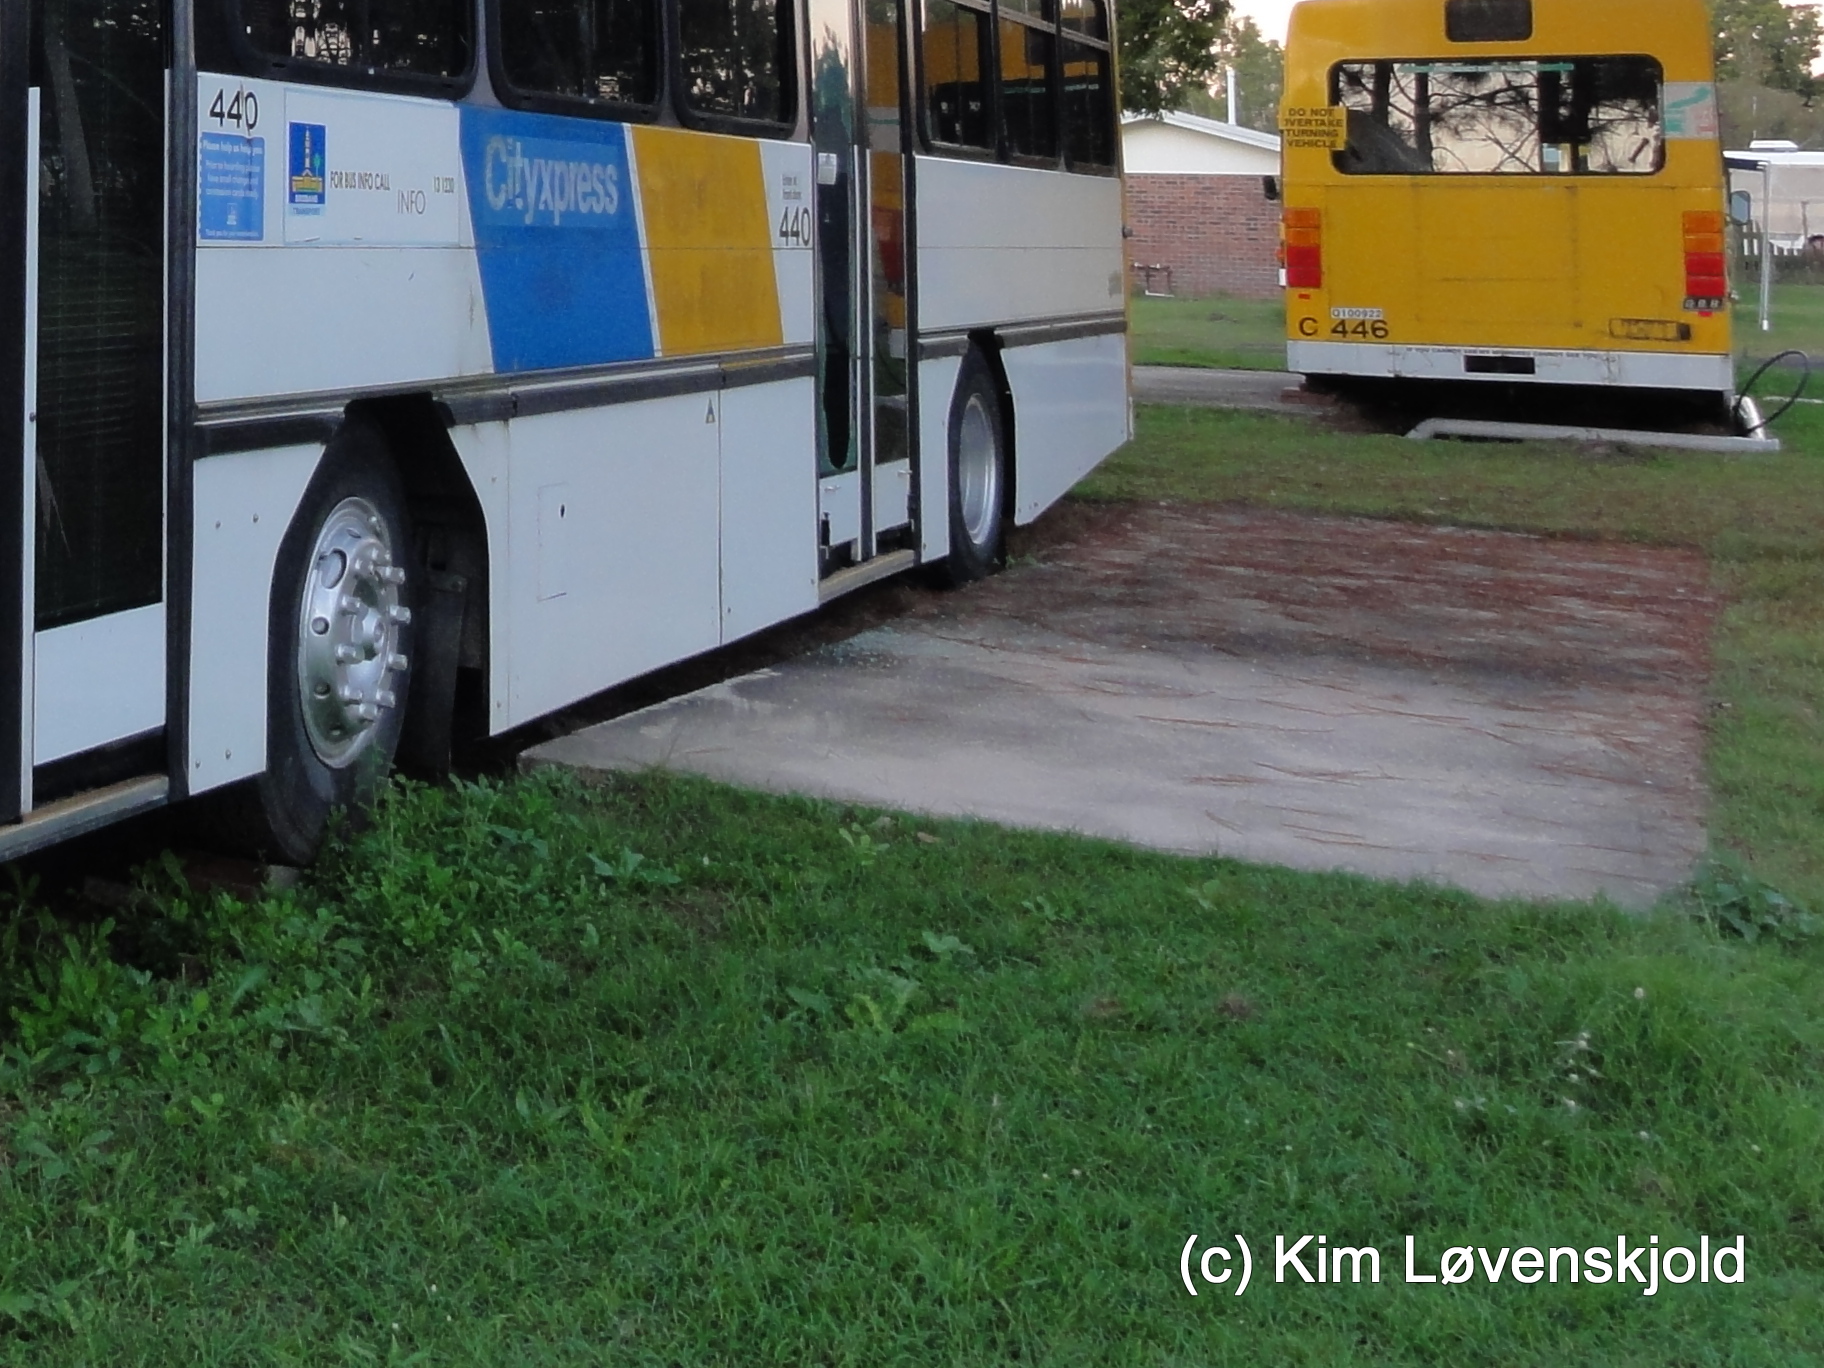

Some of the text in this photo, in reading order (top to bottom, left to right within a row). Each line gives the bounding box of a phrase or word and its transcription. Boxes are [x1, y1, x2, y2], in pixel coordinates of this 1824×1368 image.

[209, 88, 258, 130] 440
[1288, 108, 1335, 117] DO NOT
[1286, 129, 1338, 137] TURNING
[1287, 139, 1336, 148] VEHICLE
[330, 170, 390, 191] FOR BUS INFO CALL
[486, 135, 618, 225] Cityxpress
[397, 189, 426, 215] INFO
[779, 206, 811, 247] 440
[1299, 317, 1389, 339] C 446
